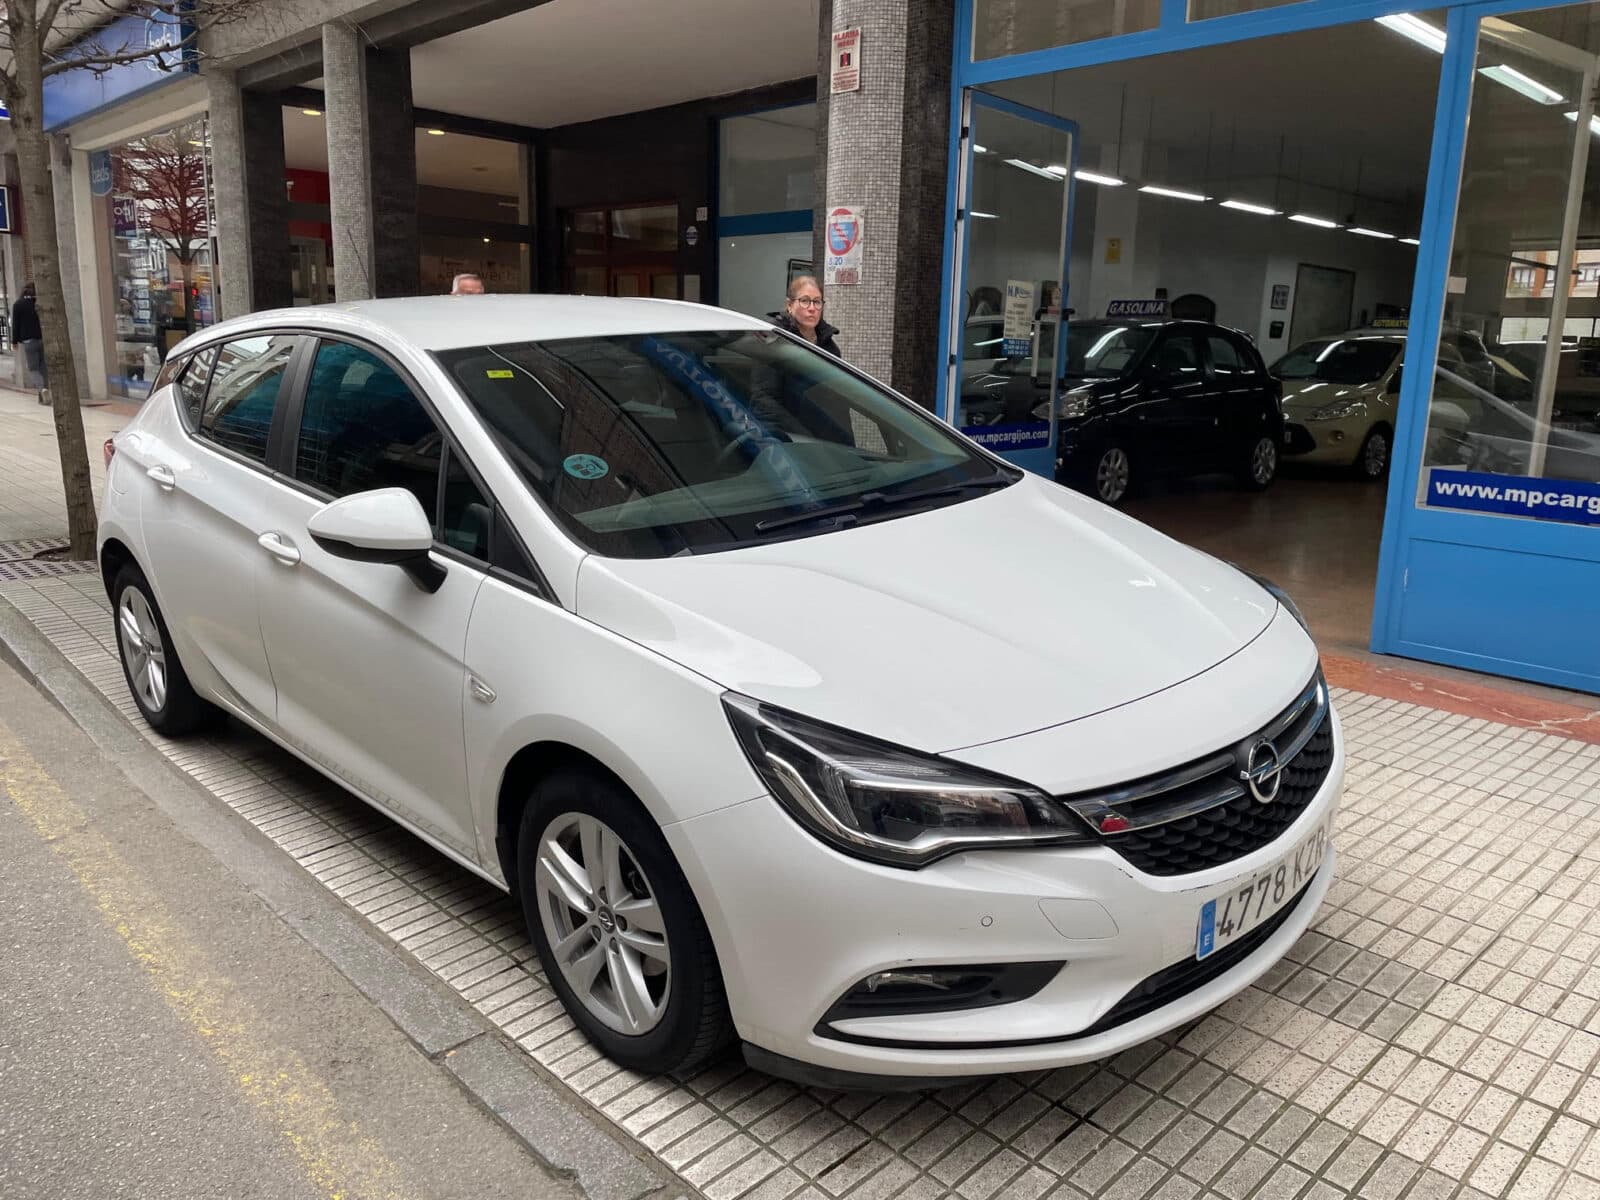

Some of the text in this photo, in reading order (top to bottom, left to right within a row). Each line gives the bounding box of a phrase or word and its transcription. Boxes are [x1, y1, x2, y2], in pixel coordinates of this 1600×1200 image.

[834, 29, 859, 40] ALARMA
[1109, 301, 1164, 315] GASOLINA
[1435, 481, 1600, 515] www.mpcarg
[1216, 825, 1325, 937] 4778 KZR
[1204, 933, 1210, 947] E
